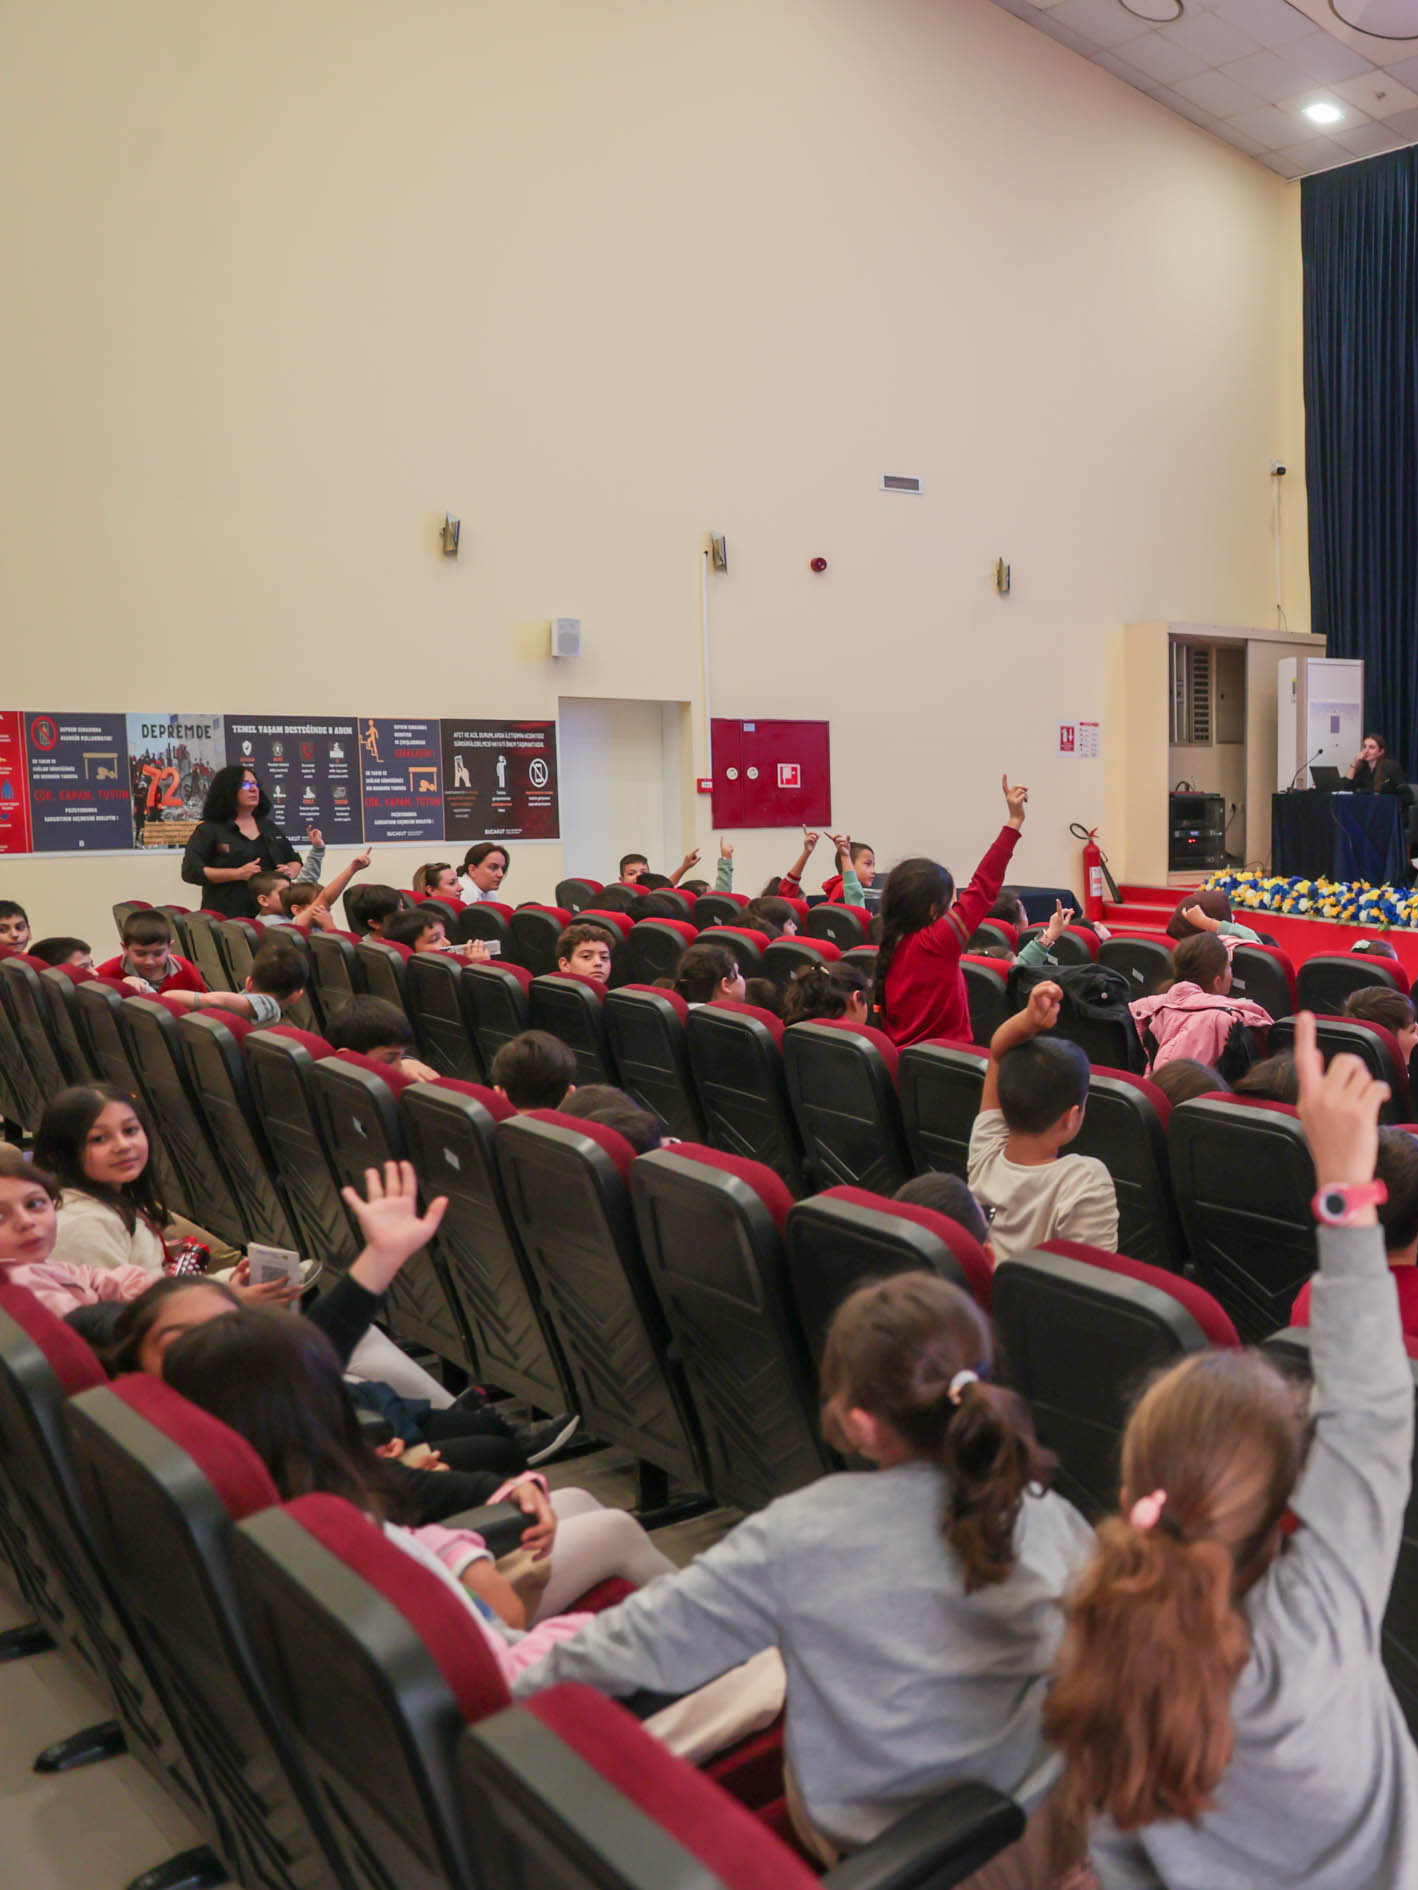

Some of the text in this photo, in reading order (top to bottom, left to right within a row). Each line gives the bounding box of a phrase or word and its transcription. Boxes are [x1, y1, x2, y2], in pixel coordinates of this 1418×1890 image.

[141, 724, 212, 739] DEPREMDE
[232, 725, 257, 734] TEMEL
[142, 763, 183, 808] 72
